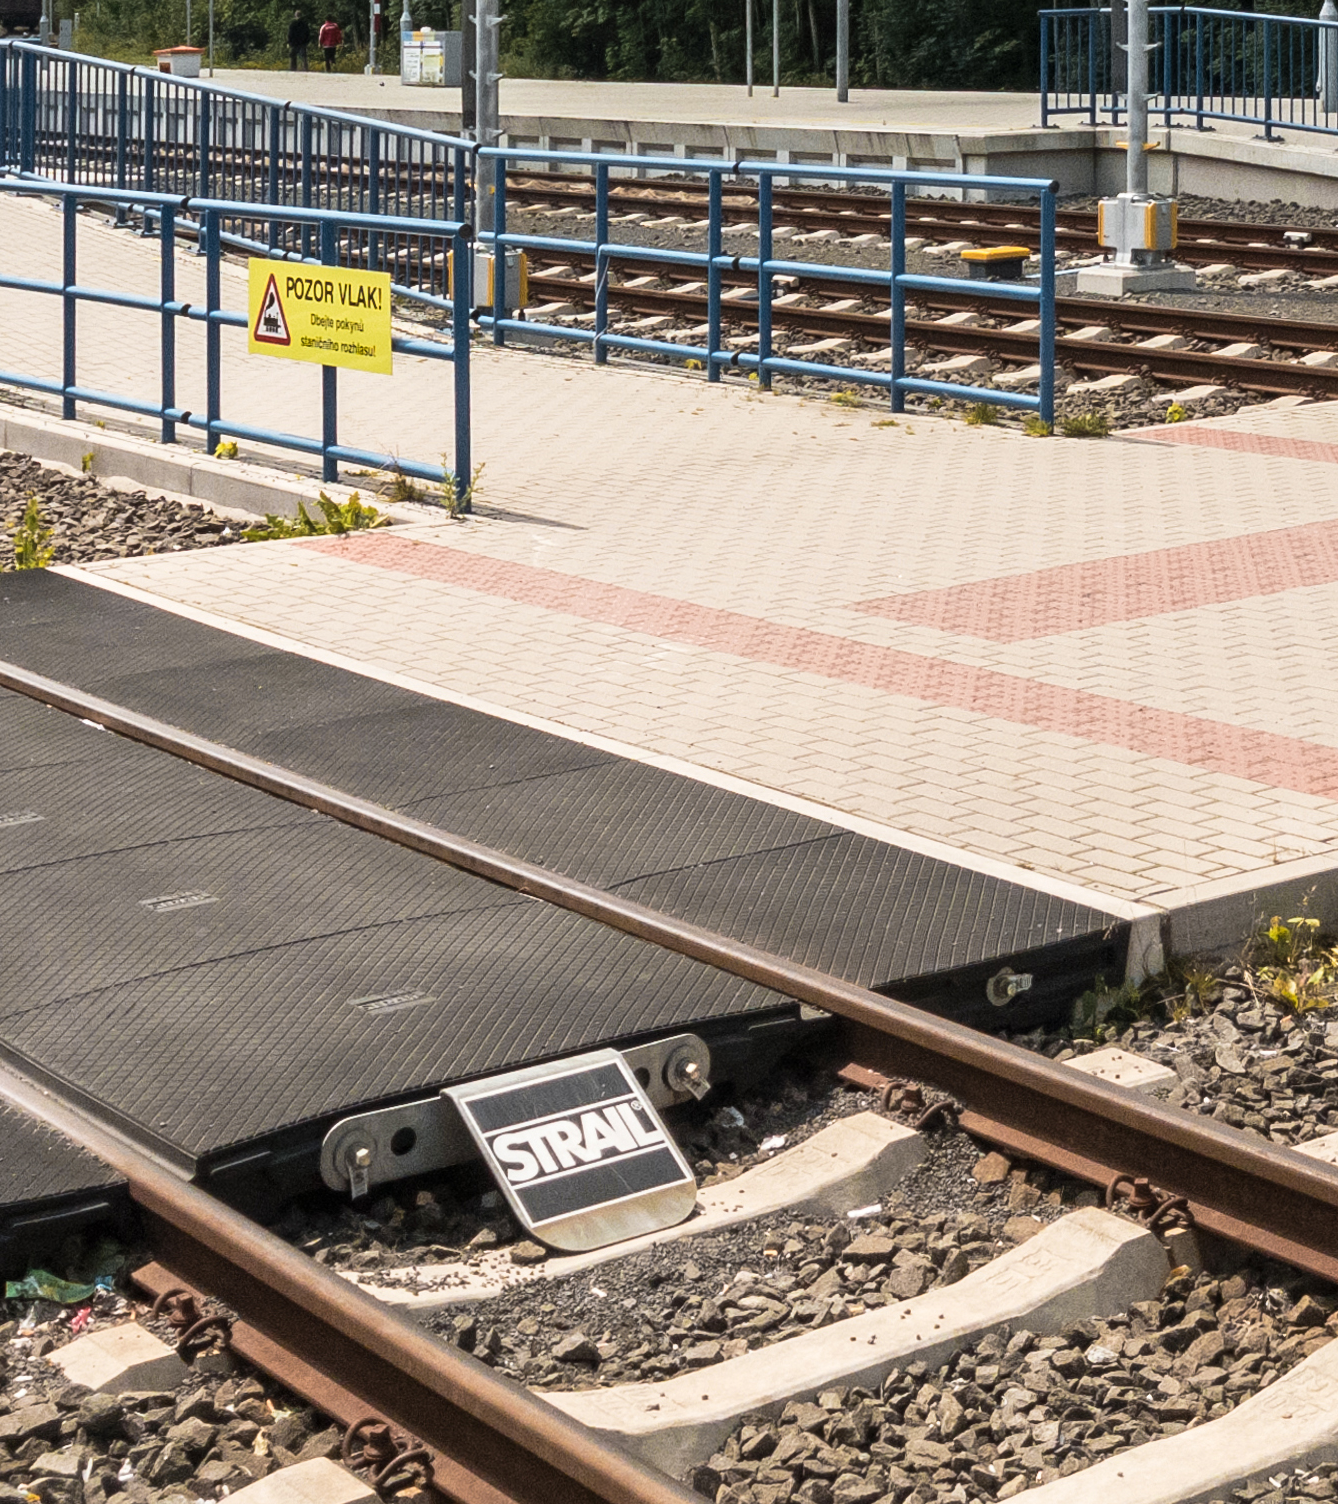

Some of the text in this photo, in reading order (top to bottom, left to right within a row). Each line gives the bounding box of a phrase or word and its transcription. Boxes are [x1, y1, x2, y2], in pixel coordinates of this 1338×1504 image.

[286, 276, 382, 311] POZOR VLAK!
[310, 313, 364, 334] Dbejte pokynů
[300, 335, 377, 358] staničního rozhlasu!
[491, 1100, 663, 1183] STRAIL
